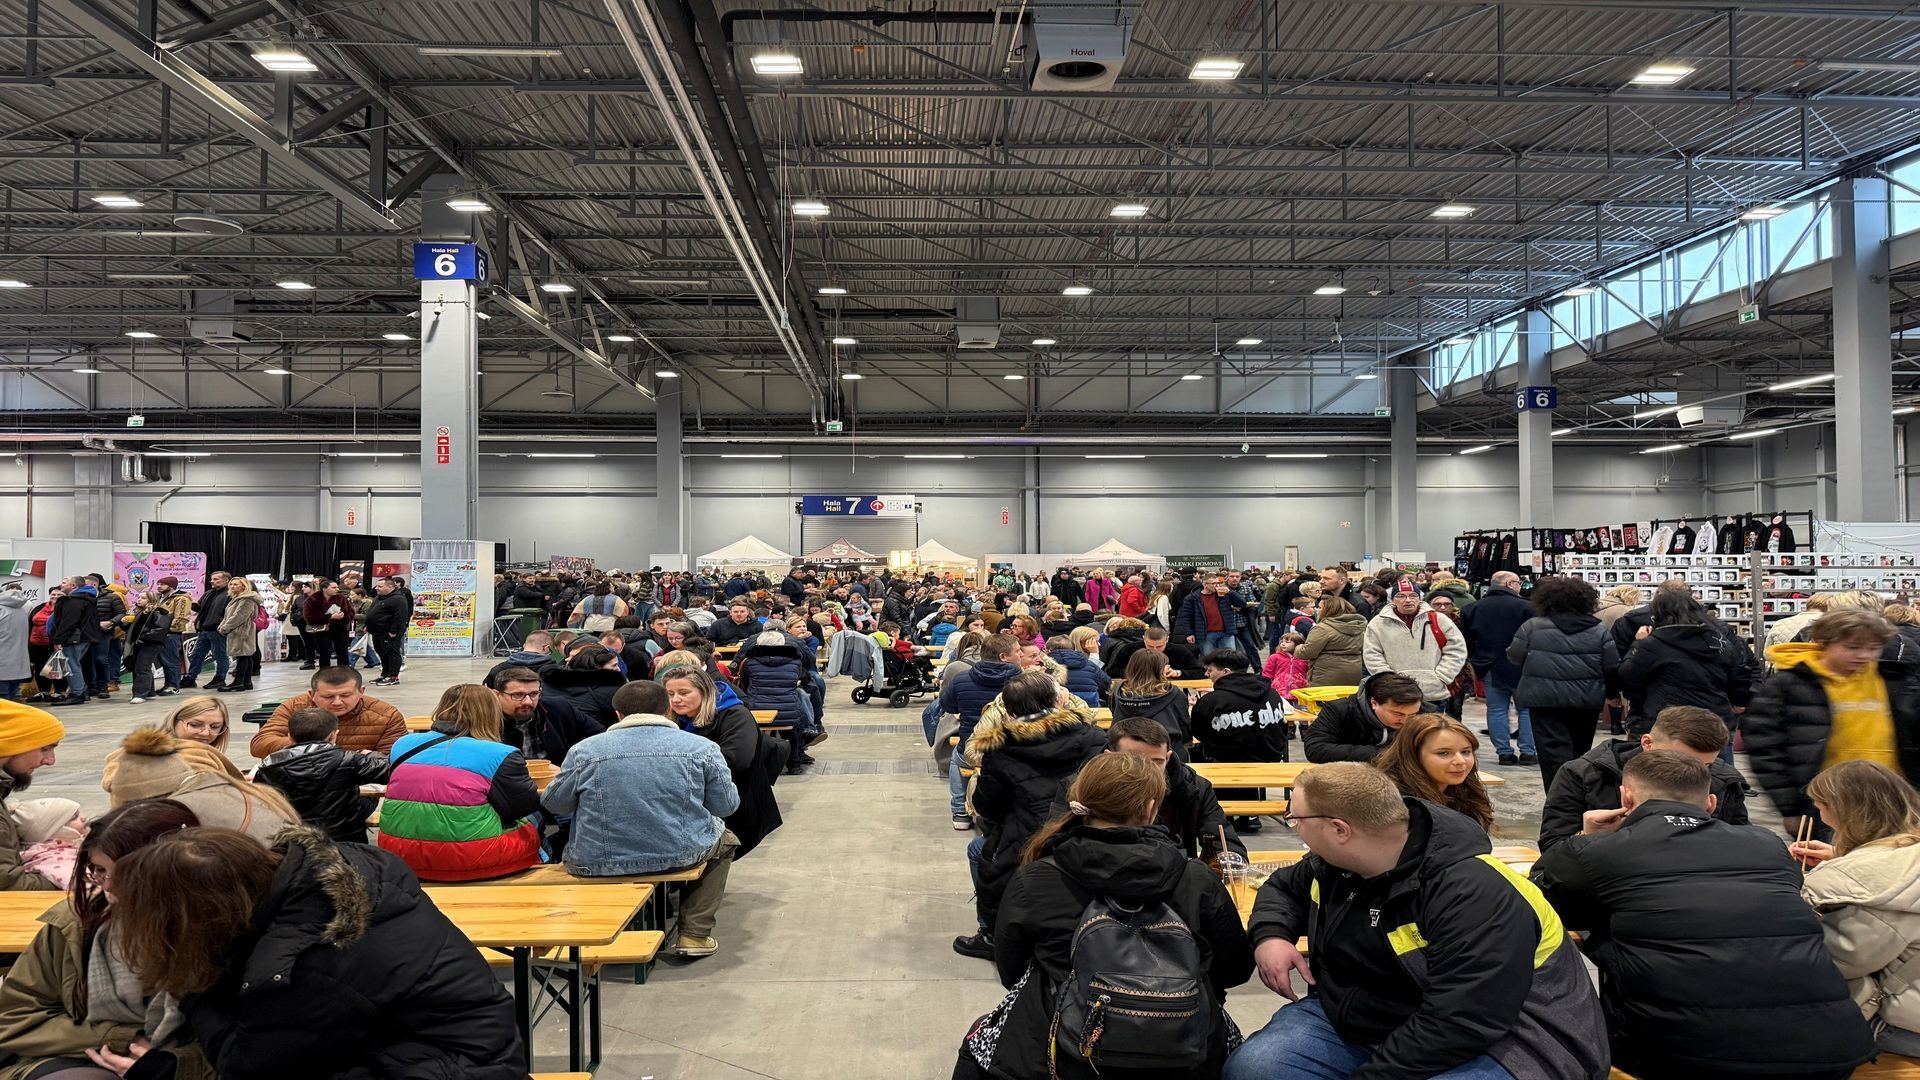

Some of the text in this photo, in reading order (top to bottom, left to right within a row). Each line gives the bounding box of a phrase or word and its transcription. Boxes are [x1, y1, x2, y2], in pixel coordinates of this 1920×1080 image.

[1070, 48, 1095, 56] Hoval
[434, 253, 456, 276] 6
[478, 259, 486, 281] 6
[1517, 394, 1525, 409] 6
[1535, 392, 1549, 407] 6
[845, 497, 862, 515] 7
[1211, 709, 1255, 731] gone
